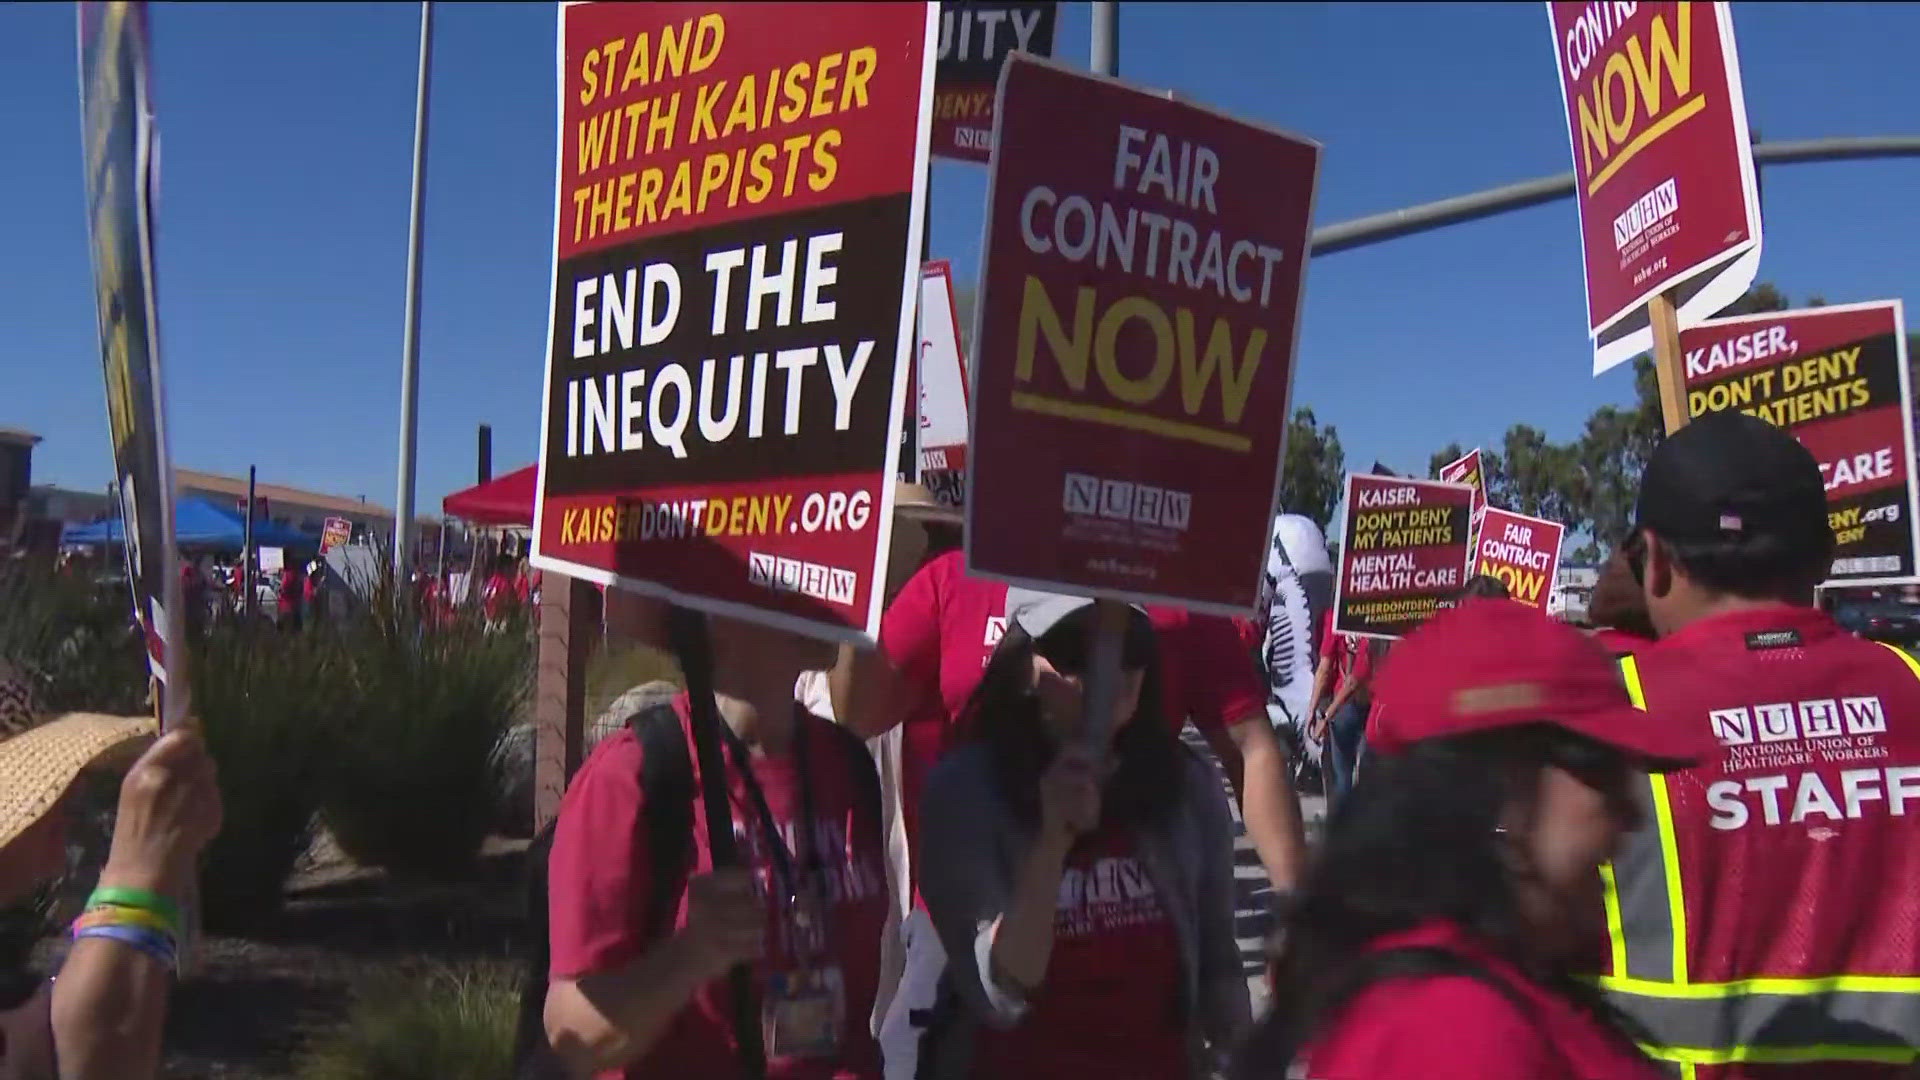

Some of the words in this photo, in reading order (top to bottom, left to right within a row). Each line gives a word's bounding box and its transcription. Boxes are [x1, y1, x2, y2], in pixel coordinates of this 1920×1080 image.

[580, 13, 726, 107] STAND
[577, 92, 681, 175] WITH
[689, 46, 877, 144] KAISER
[1578, 2, 1691, 177] NOW
[573, 129, 842, 243] THERAPISTS
[1114, 124, 1221, 215] FAIR
[1614, 177, 1679, 251] NUHW
[1021, 186, 1284, 308] CONTRACT
[573, 262, 682, 360] END
[705, 232, 844, 336] THE
[1014, 275, 1269, 424] NOW
[1685, 325, 1799, 379] KAISER,
[567, 340, 876, 459] INEQUITY
[1689, 370, 1776, 419] DON'T
[1782, 346, 1863, 394] DENY
[1740, 378, 1871, 429] ATIENTS
[561, 490, 872, 546] KAISERDONTDENY.ORG
[1063, 473, 1192, 531] NUHW
[1356, 511, 1407, 532] DON'T
[1409, 507, 1452, 527] DENY
[1358, 486, 1421, 508] KAISER,
[1353, 531, 1379, 550] MY
[1382, 526, 1453, 548] PATIENTS
[1482, 539, 1551, 572] CONTRACT
[1503, 523, 1532, 546] FAIR
[750, 551, 857, 606] NUHW
[1349, 572, 1411, 593] HEALTH
[1414, 568, 1457, 588] CARE
[1350, 552, 1416, 575] MENTAL
[1481, 560, 1546, 601] NOW
[1709, 697, 1887, 746] NUHW
[1730, 742, 1803, 761] NATIONAL
[1805, 737, 1852, 751] UNION
[1857, 736, 1875, 747] OF
[1723, 752, 1814, 774] HEALTHCARE
[1821, 746, 1889, 763] WORKERS
[1706, 766, 1920, 831] STAFF
